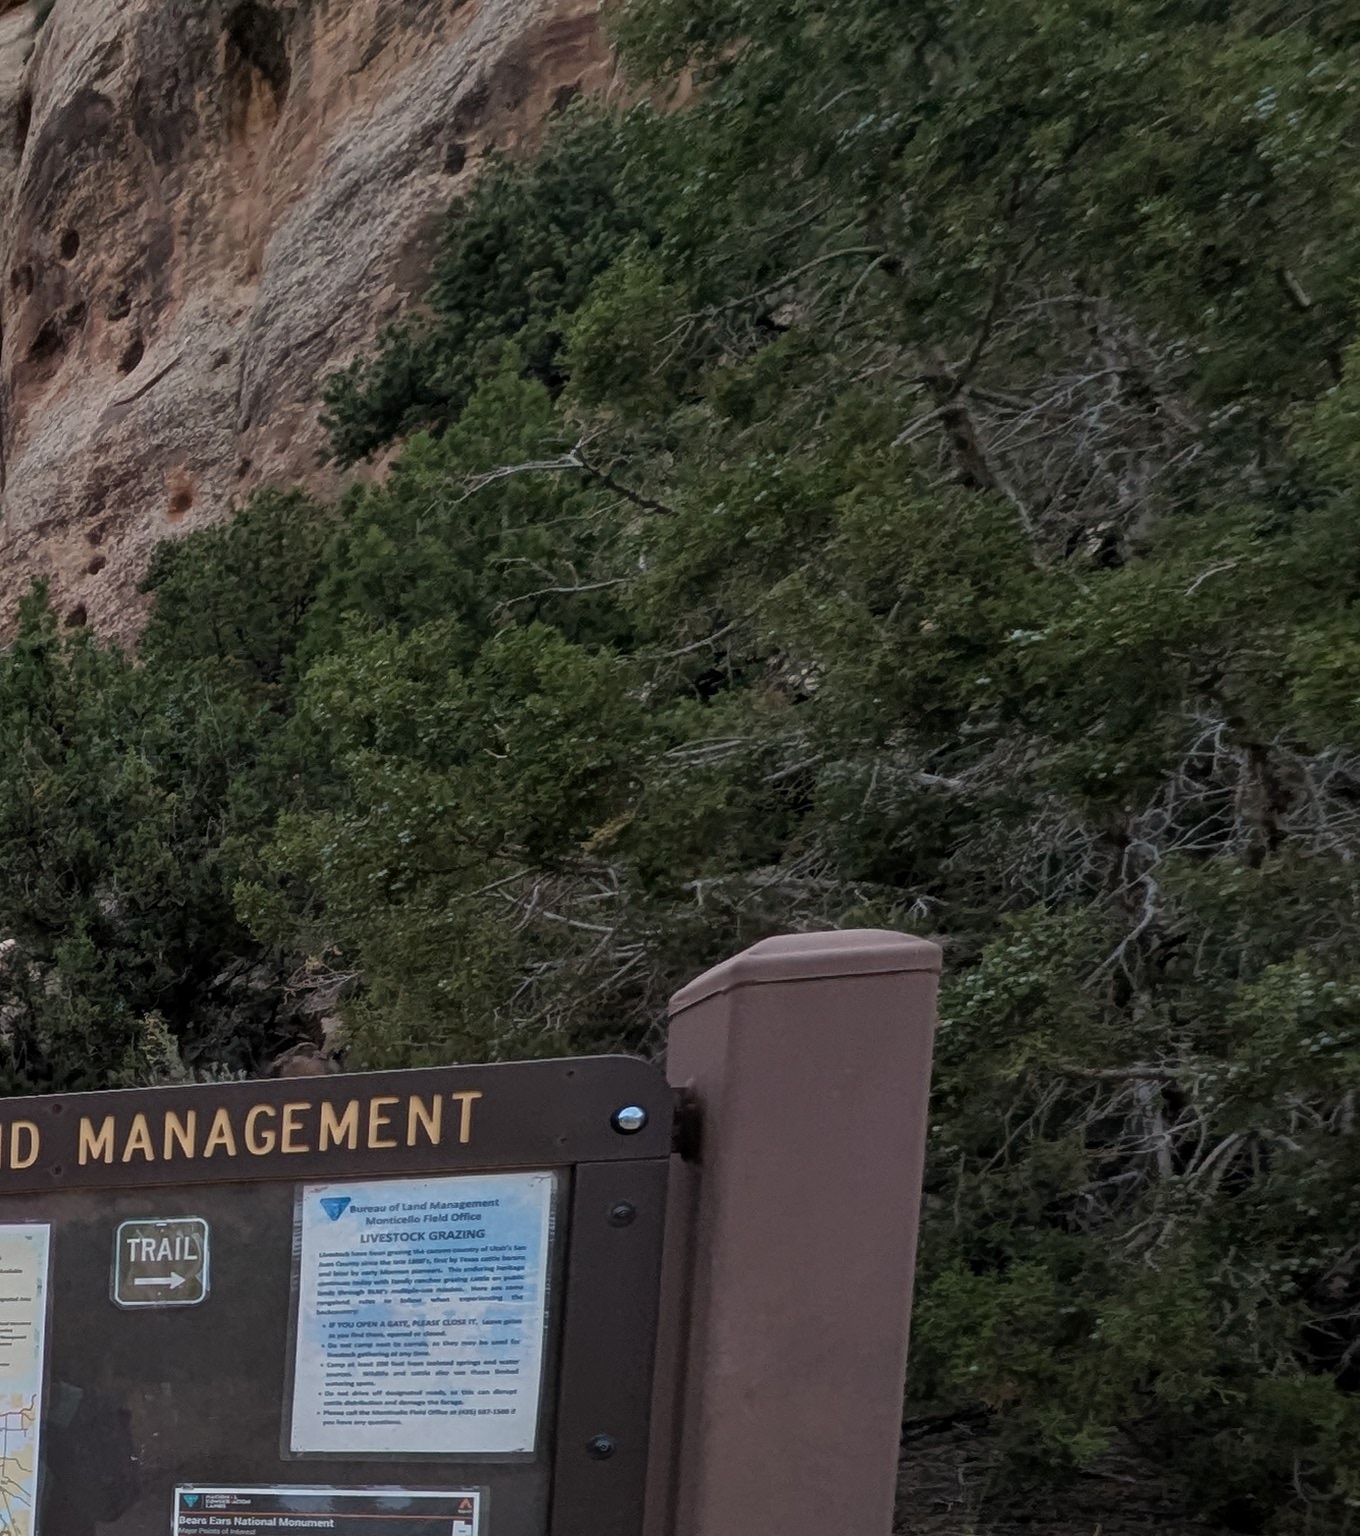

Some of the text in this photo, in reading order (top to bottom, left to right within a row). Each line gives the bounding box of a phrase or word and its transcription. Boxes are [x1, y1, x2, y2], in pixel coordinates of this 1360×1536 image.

[78, 1090, 482, 1165] MANAGEMENT
[349, 1198, 499, 1213] Bureau of Land Management
[365, 1211, 481, 1225] Monticello Field Office
[359, 1229, 485, 1244] LIVESTOCK GRAZING
[126, 1236, 202, 1262] TRAIL
[178, 1515, 334, 1528] Bears Ears National Monument
[178, 1527, 197, 1535] Major
[199, 1527, 220, 1535] Points
